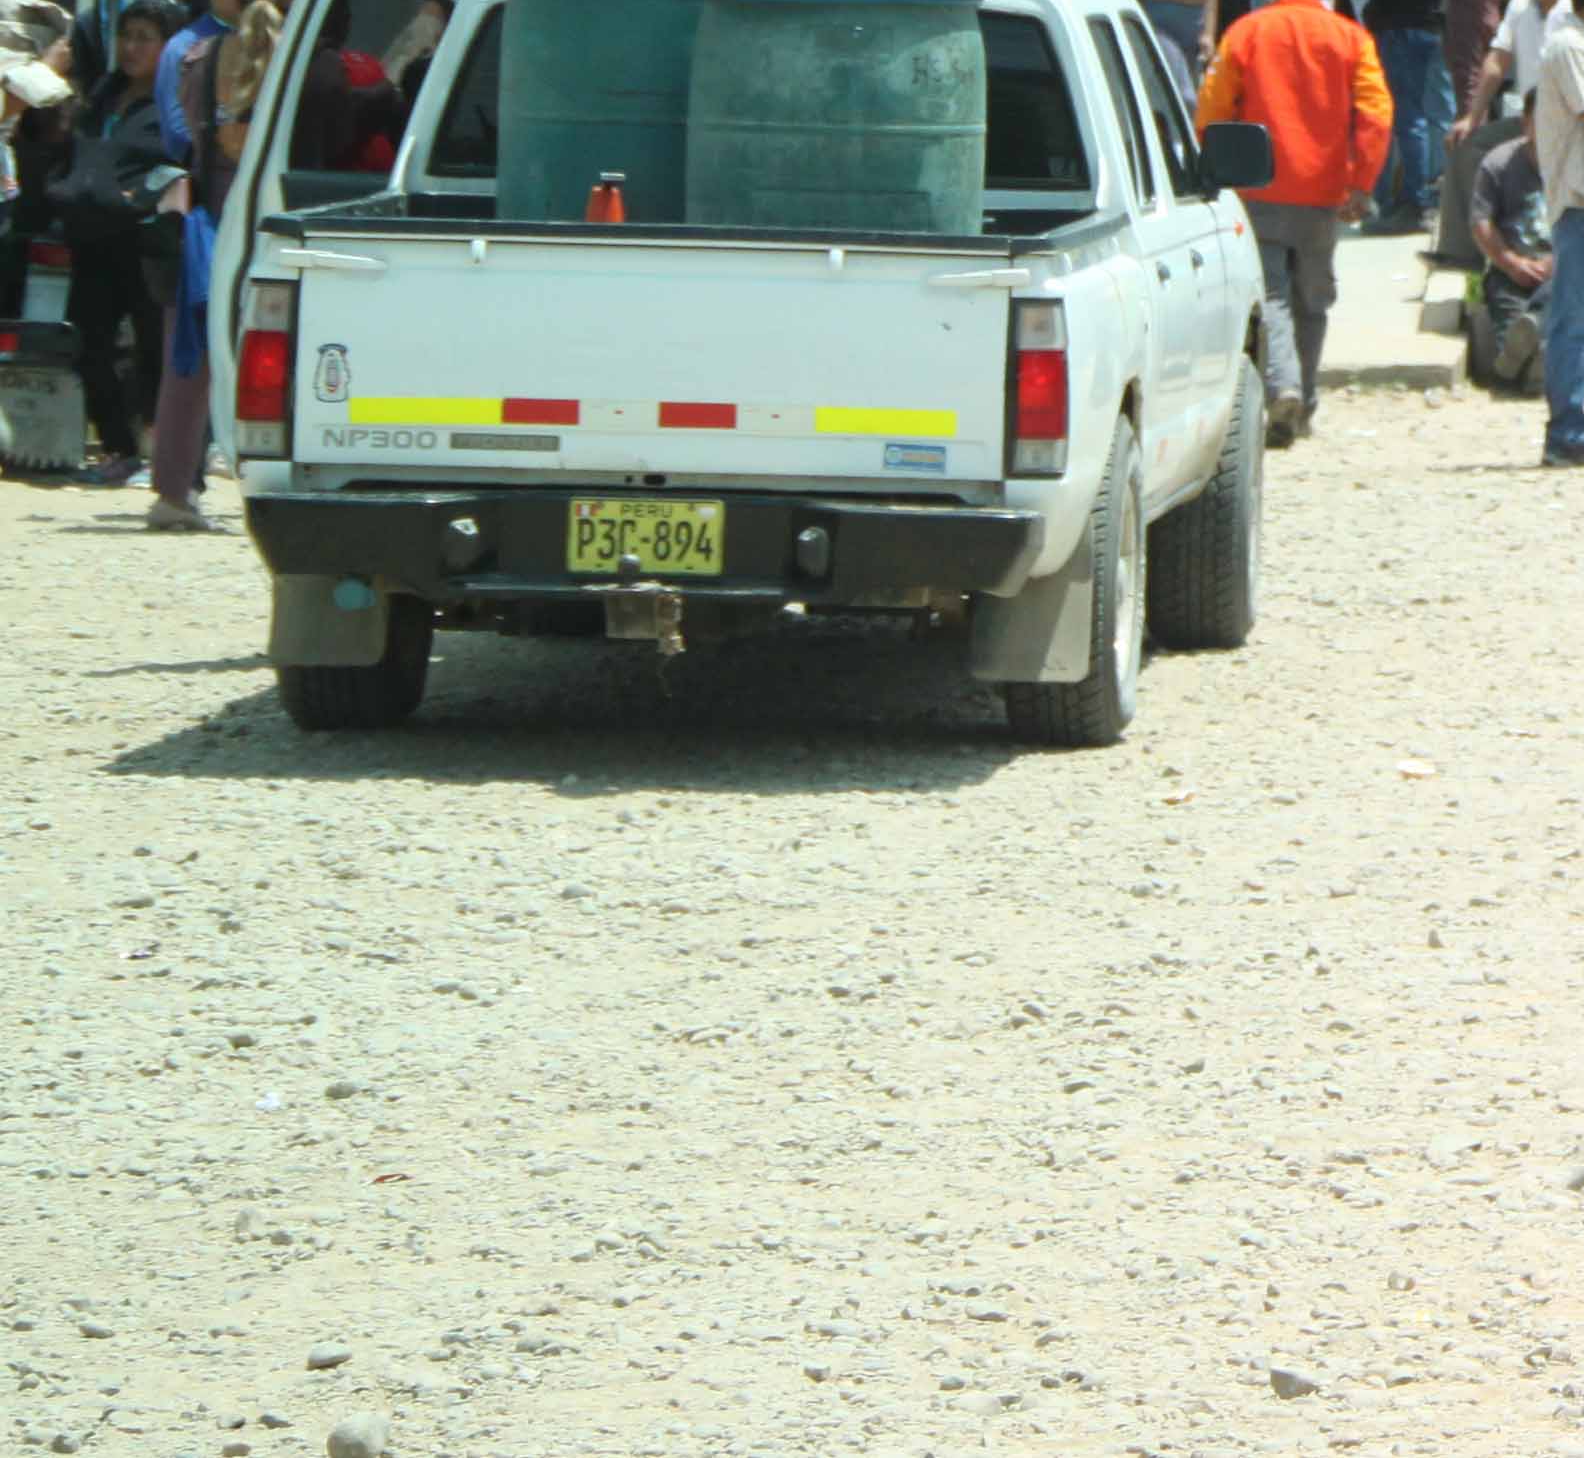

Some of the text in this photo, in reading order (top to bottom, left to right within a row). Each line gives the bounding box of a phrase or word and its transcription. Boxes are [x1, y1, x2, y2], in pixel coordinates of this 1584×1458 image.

[321, 428, 438, 450] NP300
[621, 503, 673, 518] PERU
[575, 518, 714, 563] P3C-894
